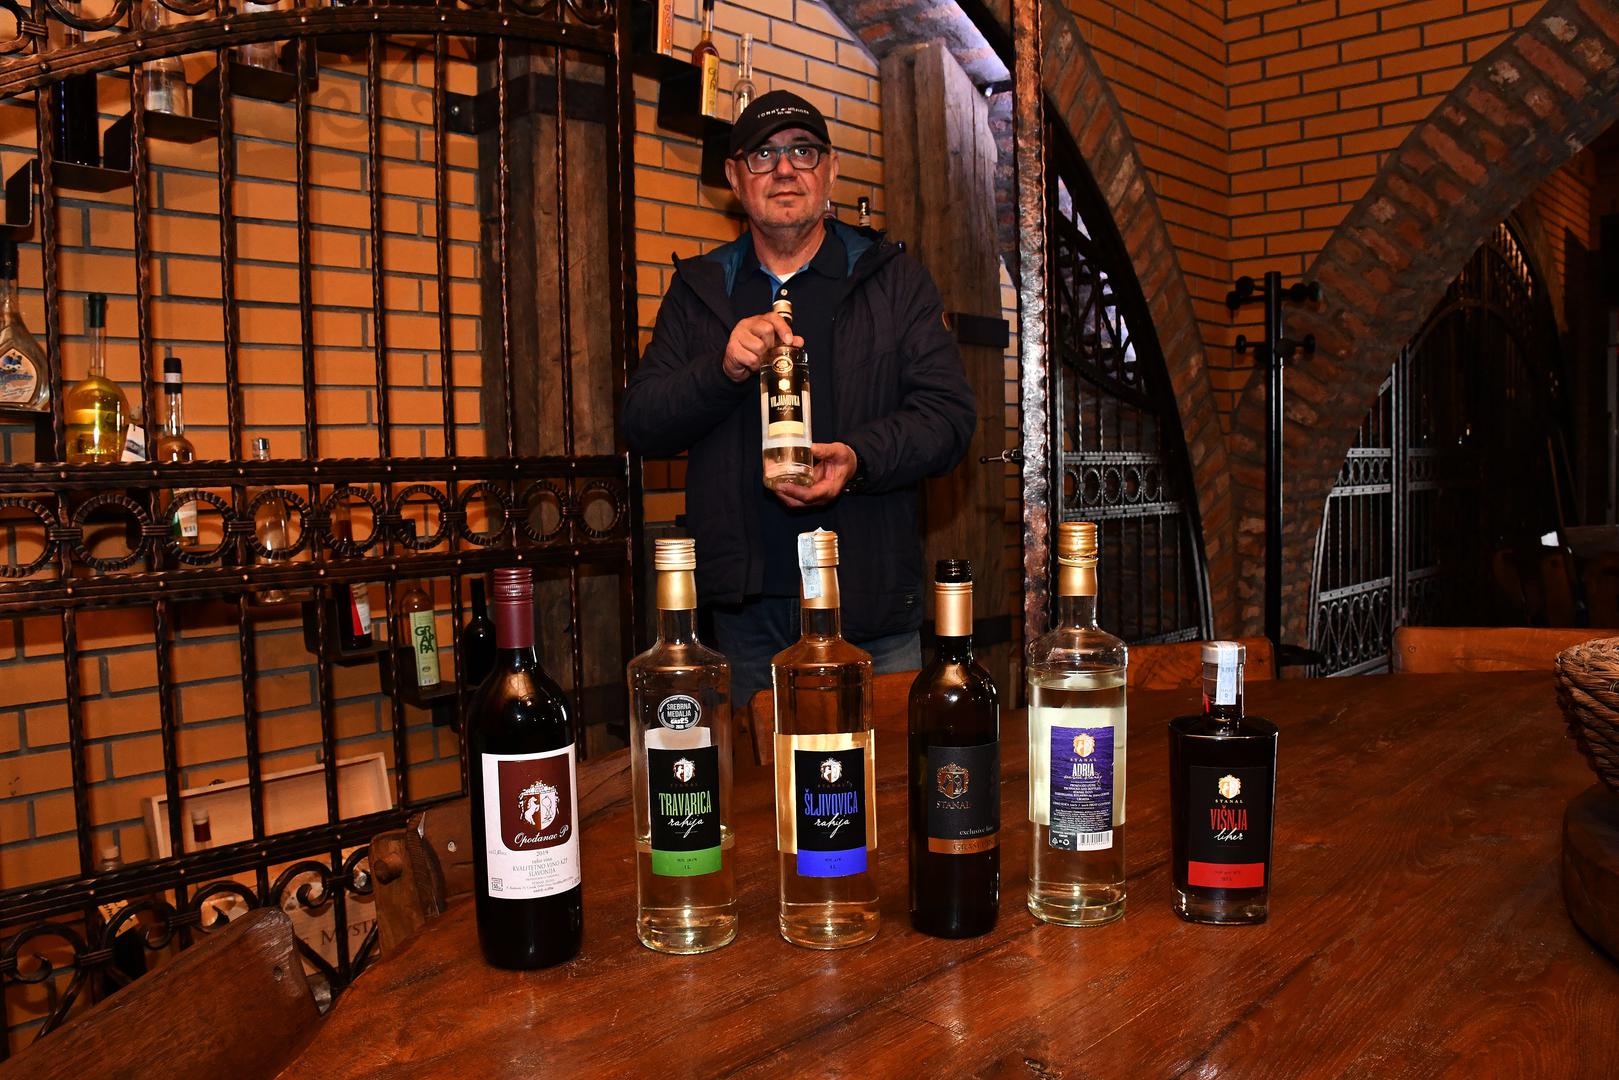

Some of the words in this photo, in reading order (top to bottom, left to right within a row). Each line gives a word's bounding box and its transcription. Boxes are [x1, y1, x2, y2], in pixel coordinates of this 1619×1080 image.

[666, 702, 692, 711] SREBRNA
[666, 709, 692, 718] MEDALJA
[1072, 763, 1095, 777] ADRIA
[658, 790, 712, 816] TRAVARICA
[804, 788, 858, 816] ŠLJIVOVICA
[814, 812, 851, 838] rakija
[1210, 805, 1248, 831] VIŠNJA
[667, 813, 705, 838] rakija
[1214, 827, 1244, 841] liker
[513, 864, 547, 872] KVALITETNO
[528, 868, 556, 877] SLAVONIJA
